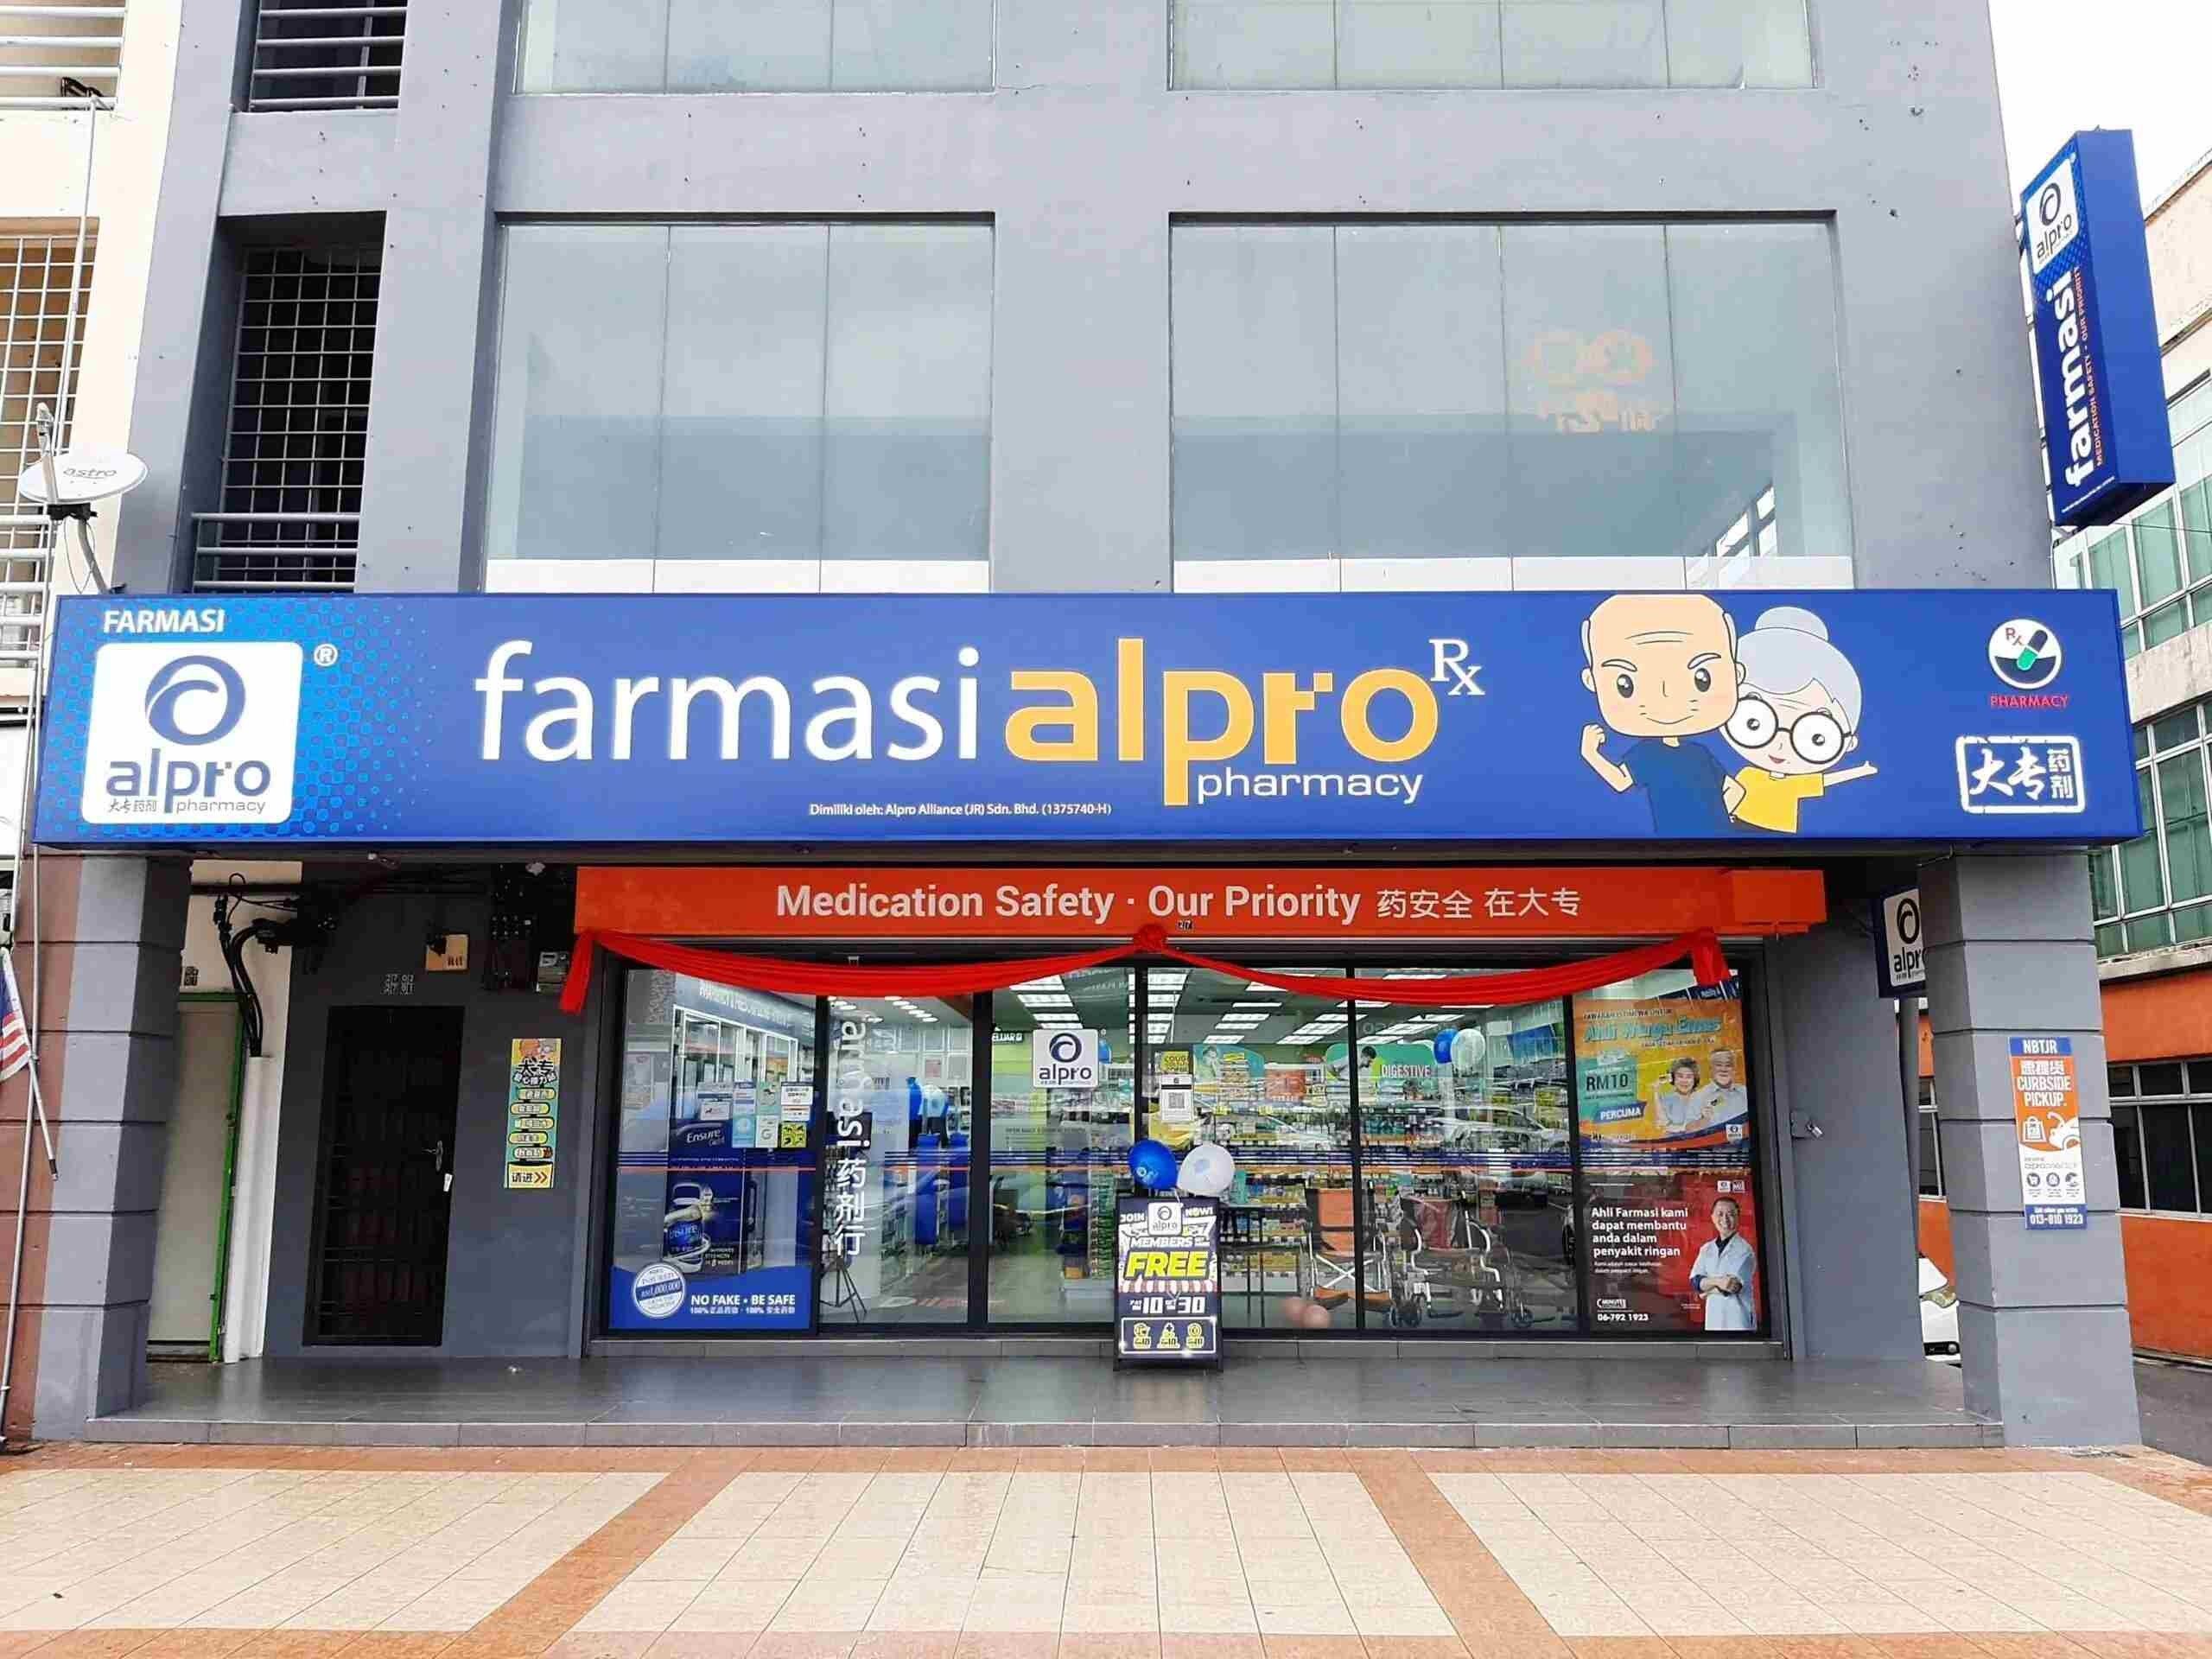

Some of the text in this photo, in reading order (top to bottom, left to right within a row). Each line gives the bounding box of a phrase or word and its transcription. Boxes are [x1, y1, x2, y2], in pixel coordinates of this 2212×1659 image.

[2037, 213, 2072, 258] alpro
[2046, 271, 2094, 487] farmasi
[2089, 398, 2104, 467] MEDICATION
[103, 608, 225, 632] FARMASI
[1990, 696, 2069, 709] PHARMACY
[475, 640, 979, 760] farmasi
[1005, 638, 1438, 805] alpro
[105, 747, 270, 813] alpro
[1969, 747, 2047, 801] 大专
[1198, 767, 1423, 804] pharmacy
[176, 799, 265, 814] pharmacy
[886, 804, 916, 817] Alpro
[918, 804, 963, 815] Alliance
[987, 804, 1013, 815] Sdn.
[1014, 804, 1039, 815] Bhd.
[777, 883, 1582, 925] Medication Safety Our Priority 药安全 在大专
[1893, 947, 1926, 979] alpr
[2023, 1039, 2057, 1054] NBTJR
[1039, 1064, 1091, 1085] alpro
[1382, 1065, 1431, 1078] DIGESTIVE
[2018, 1076, 2072, 1090] CURBSIDE
[1600, 1107, 1641, 1121] PERCUMA
[687, 1129, 721, 1144] Ensure
[835, 1158, 867, 1257] 药剂行
[1591, 1208, 1688, 1217] Ahli Farmasi kami
[1592, 1221, 1687, 1232] dapat membantu
[1592, 1234, 1657, 1243] anda dalam
[1593, 1247, 1681, 1259] penyakit ringan
[1124, 1251, 1209, 1278] FREE
[691, 1295, 795, 1305] NO FAKE BE SAFE
[1629, 1313, 1649, 1322] 1923
